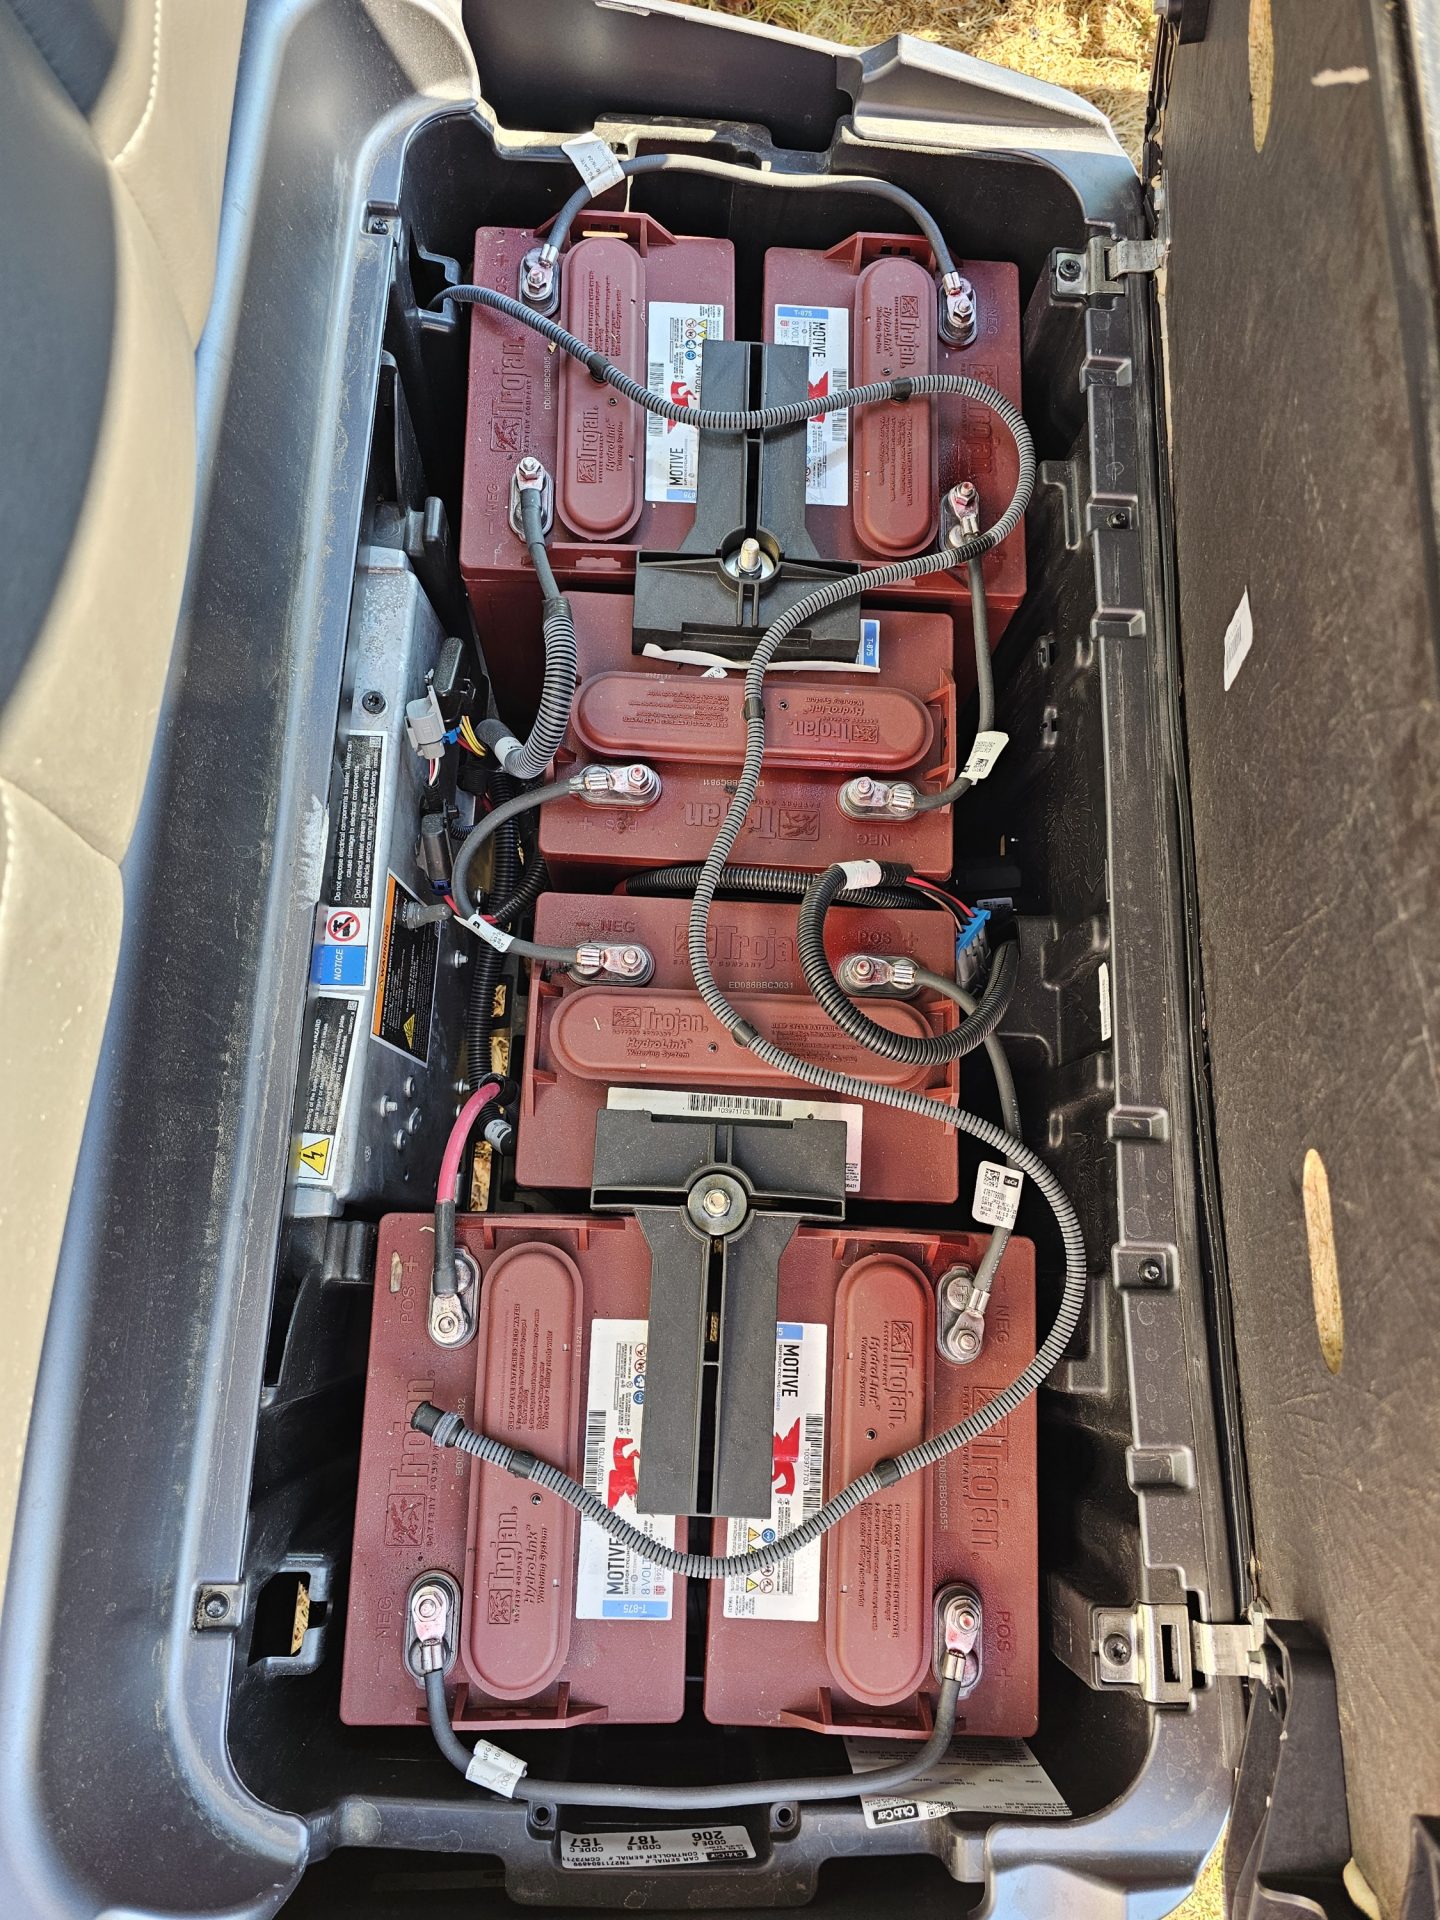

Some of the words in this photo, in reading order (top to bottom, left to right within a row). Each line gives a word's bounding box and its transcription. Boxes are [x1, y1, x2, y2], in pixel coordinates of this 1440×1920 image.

[792, 326, 800, 344] VOLT
[986, 308, 998, 336] NEG
[812, 322, 826, 358] MOTIVE
[897, 318, 921, 367] Trojan
[492, 341, 530, 415] Trojan
[577, 408, 601, 458] Trojan
[669, 448, 684, 486] MOTIVE
[486, 484, 499, 511] NEG
[793, 719, 851, 744] Trojan
[368, 798, 376, 817] before
[604, 819, 638, 831] POS
[857, 833, 890, 845] NEG
[334, 892, 341, 900] Do
[340, 796, 349, 831] components
[346, 834, 355, 858] damage
[638, 866, 656, 874] T-875
[354, 889, 361, 899] Do
[600, 921, 635, 933] NEG
[857, 931, 891, 943] POS
[380, 924, 390, 977] WARNING
[718, 926, 797, 968] Troja
[334, 948, 344, 981] NOTICE
[641, 1007, 706, 1034] Trojan
[626, 1037, 686, 1050] HydroLink
[400, 1285, 415, 1325] POS
[996, 1305, 1010, 1342] NEG
[782, 1344, 800, 1397] MOTIVE
[860, 1336, 868, 1375] Watering
[868, 1336, 880, 1404] HydroLink
[858, 1377, 868, 1407] System
[884, 1354, 914, 1426] Trojan
[597, 1447, 606, 1486] 103971703
[962, 1439, 1009, 1547] Trojan
[426, 1494, 437, 1548] BATTERY
[489, 1508, 522, 1589] Trojan
[539, 1528, 549, 1561] System
[524, 1532, 538, 1604] HydroLink
[537, 1563, 548, 1604] Watering
[376, 1596, 394, 1641] NEG
[624, 1604, 648, 1614] T-875
[996, 1608, 1010, 1649] POS
[570, 1837, 602, 1848] 157
[628, 1835, 659, 1846] 187
[692, 1830, 724, 1842] 206
[646, 1852, 698, 1860] CONTROLLER
